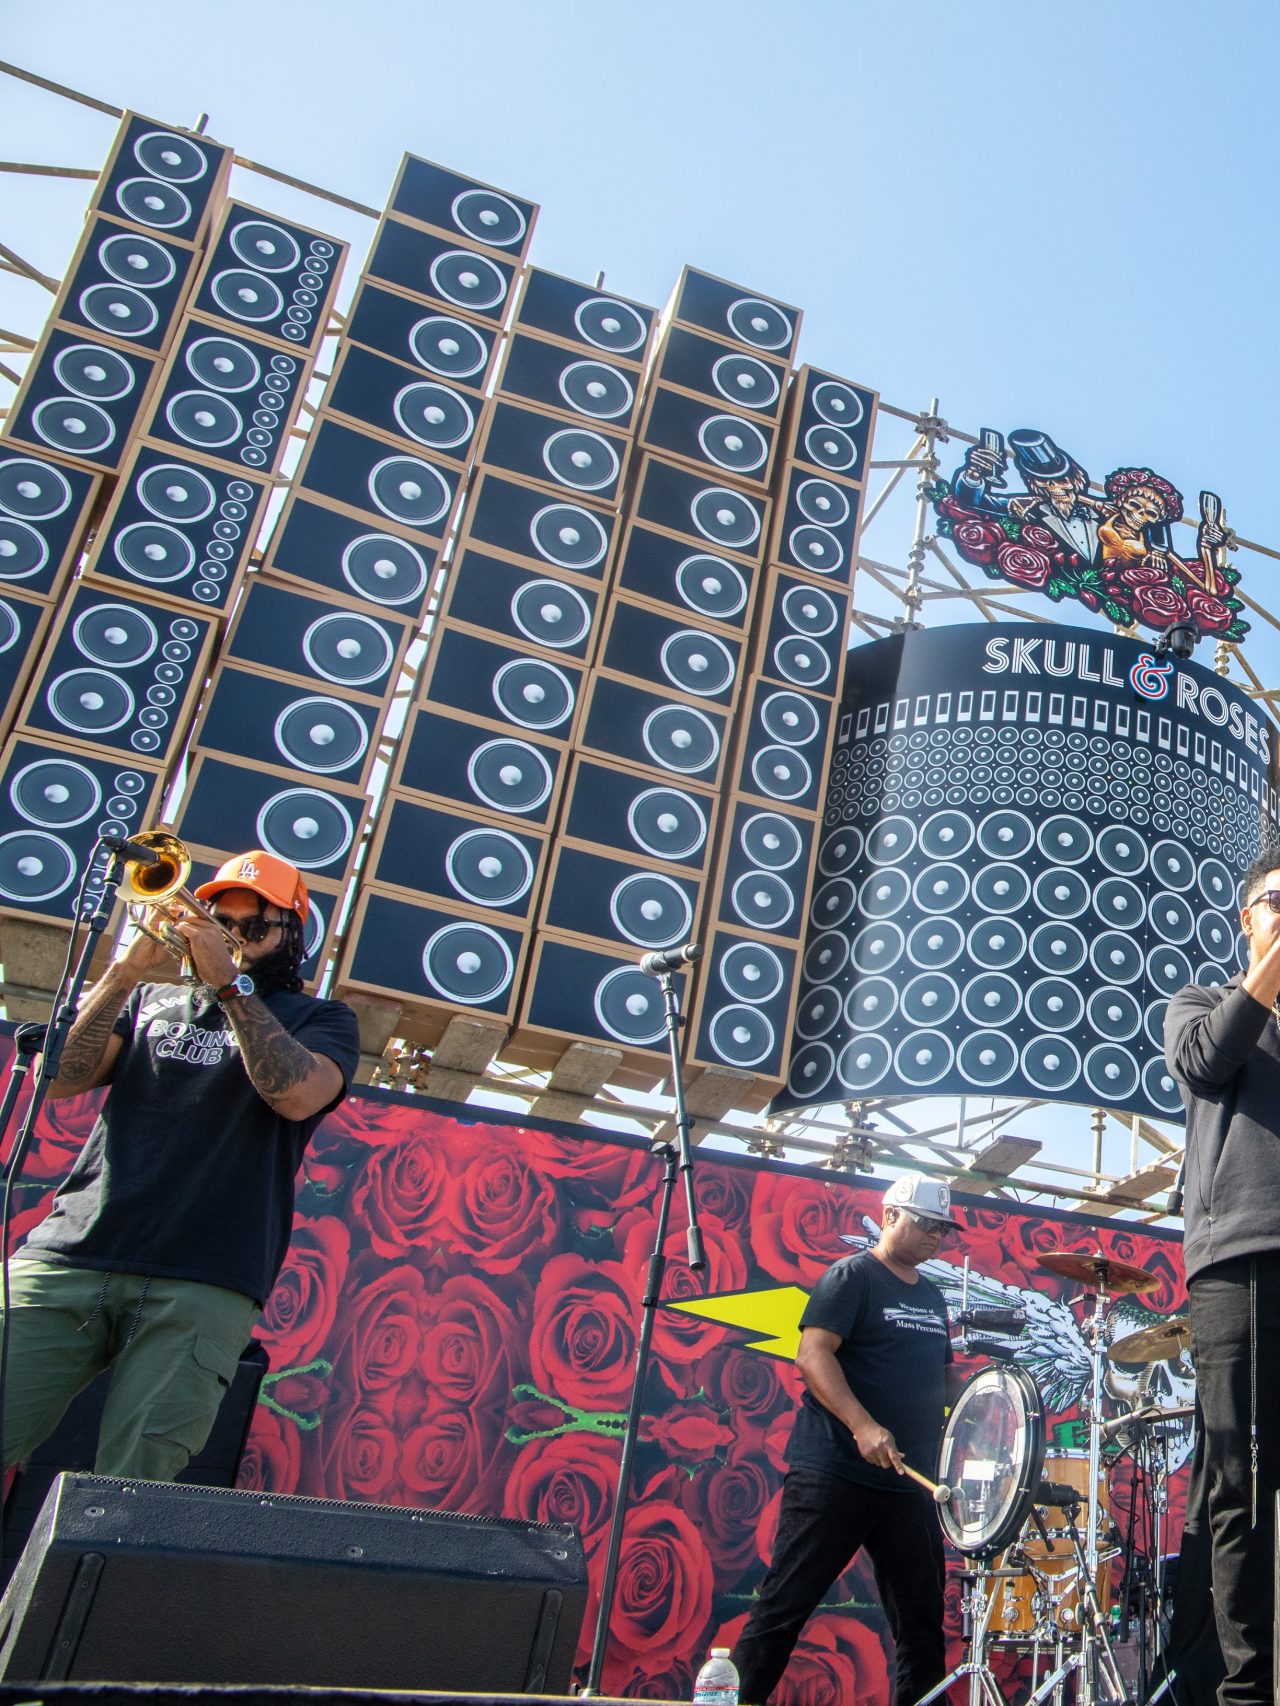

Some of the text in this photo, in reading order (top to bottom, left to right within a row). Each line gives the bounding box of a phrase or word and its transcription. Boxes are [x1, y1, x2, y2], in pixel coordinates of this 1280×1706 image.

[982, 637, 1270, 765] SKULL & ROSES
[238, 858, 260, 879] LA
[147, 1020, 240, 1047] BOXING
[156, 1039, 223, 1064] CLUB
[899, 1303, 927, 1314] Weapons
[896, 1320, 915, 1330] Mass
